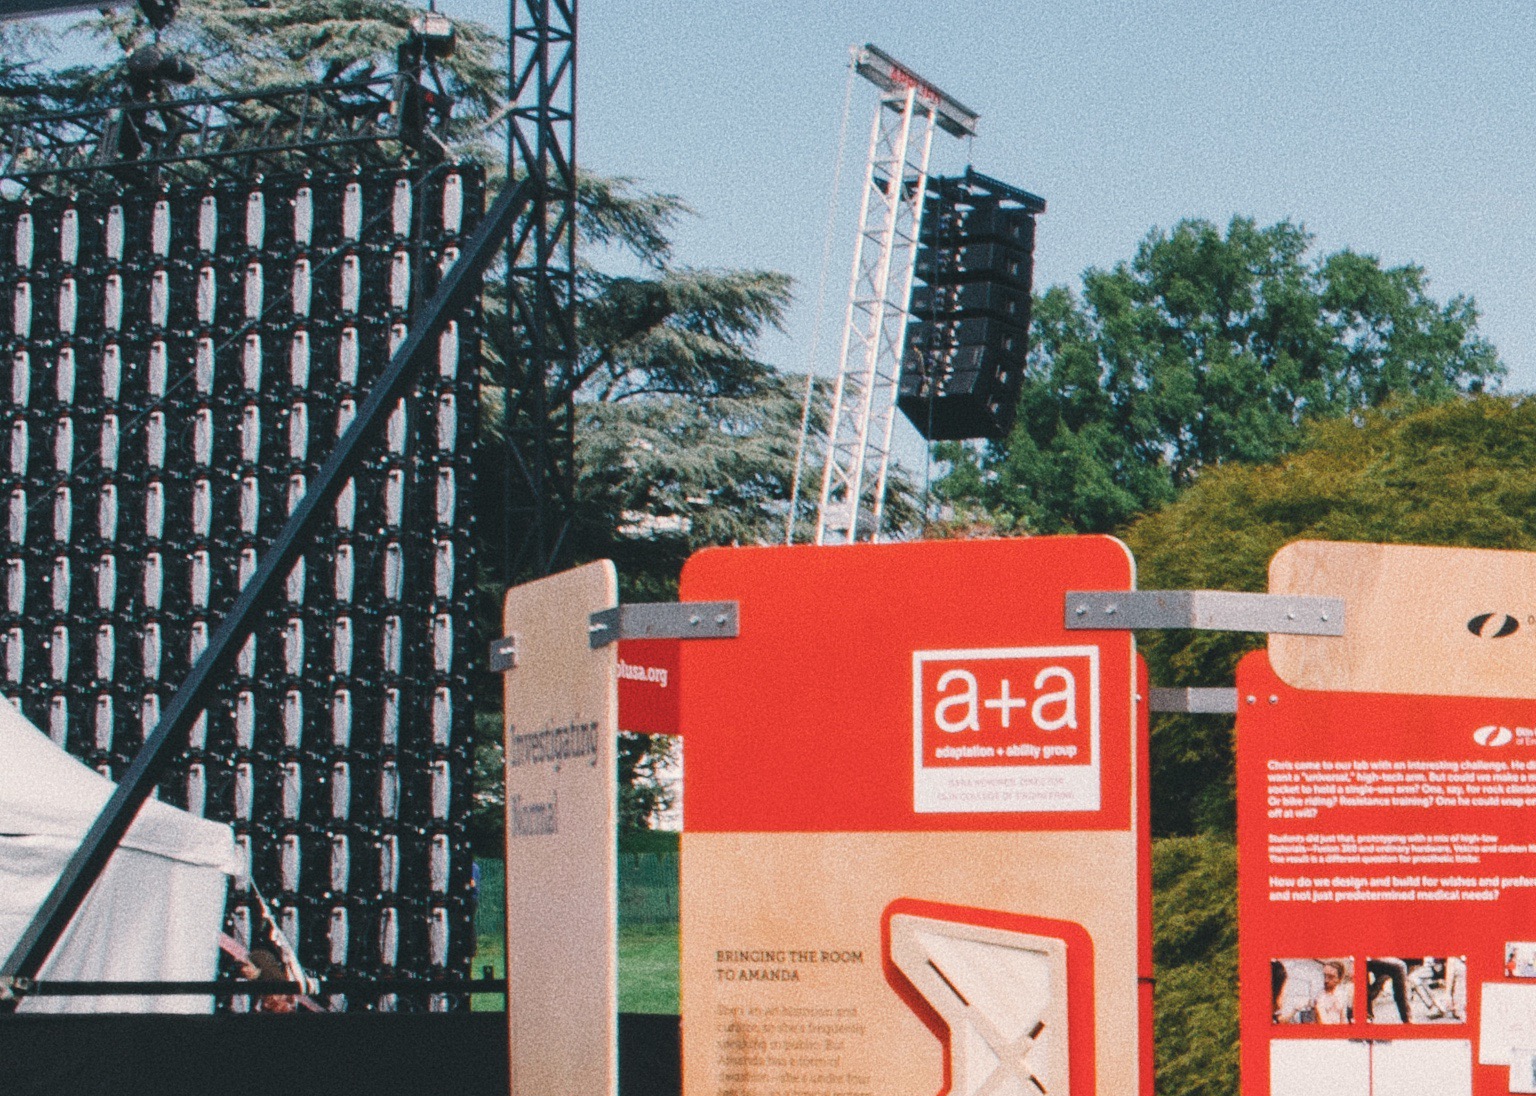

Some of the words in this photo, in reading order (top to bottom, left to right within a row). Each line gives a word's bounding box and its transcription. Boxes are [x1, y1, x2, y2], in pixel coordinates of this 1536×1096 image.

[934, 666, 1078, 733] a+a
[1515, 727, 1533, 738] Olin
[510, 718, 598, 773] Investigating
[935, 746, 995, 760] adaptation
[996, 748, 1004, 756] +
[1006, 744, 1041, 760] ability
[1042, 744, 1078, 760] group
[510, 790, 558, 837] Normal
[716, 950, 786, 964] BRINGING
[789, 950, 817, 964] THE
[820, 950, 864, 964] ROOM
[716, 968, 735, 982] TO
[738, 968, 801, 982] AMANDA
